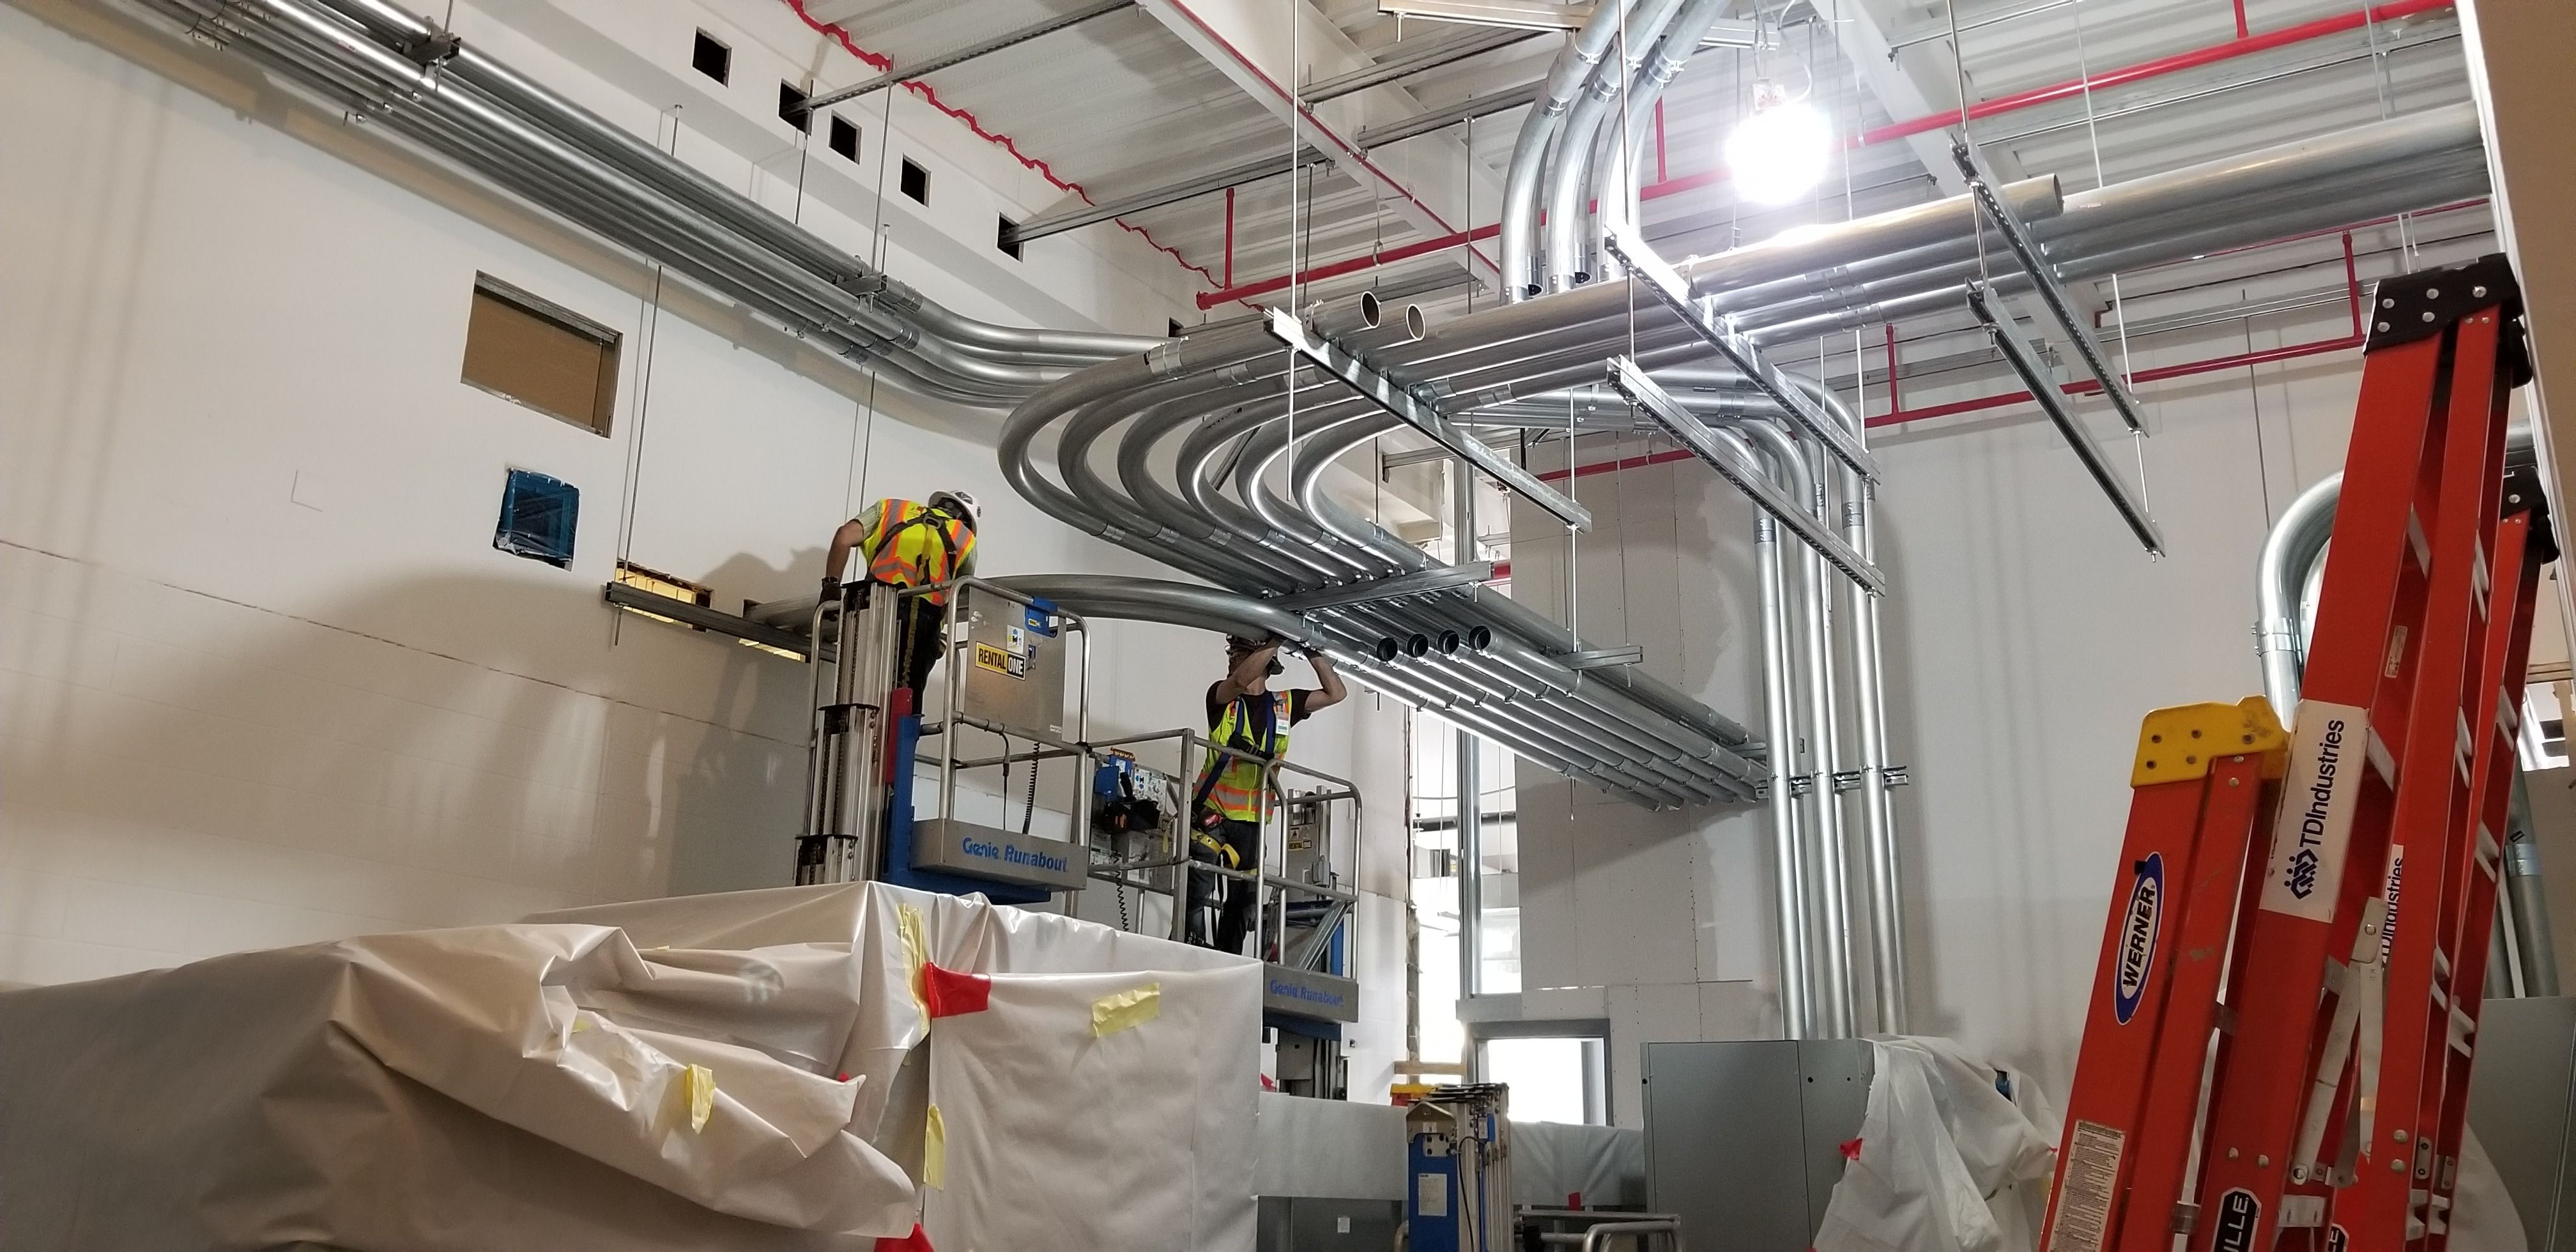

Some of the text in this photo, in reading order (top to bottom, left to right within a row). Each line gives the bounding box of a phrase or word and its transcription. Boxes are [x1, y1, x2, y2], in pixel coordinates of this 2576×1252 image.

[978, 648, 1023, 675] RENTAL ONE
[2299, 719, 2345, 848] TDIndustries
[962, 837, 999, 859] Genie
[1004, 843, 1068, 873] Runabout
[2122, 886, 2156, 987] WERNER
[1270, 979, 1344, 1007] Genie Runabout
